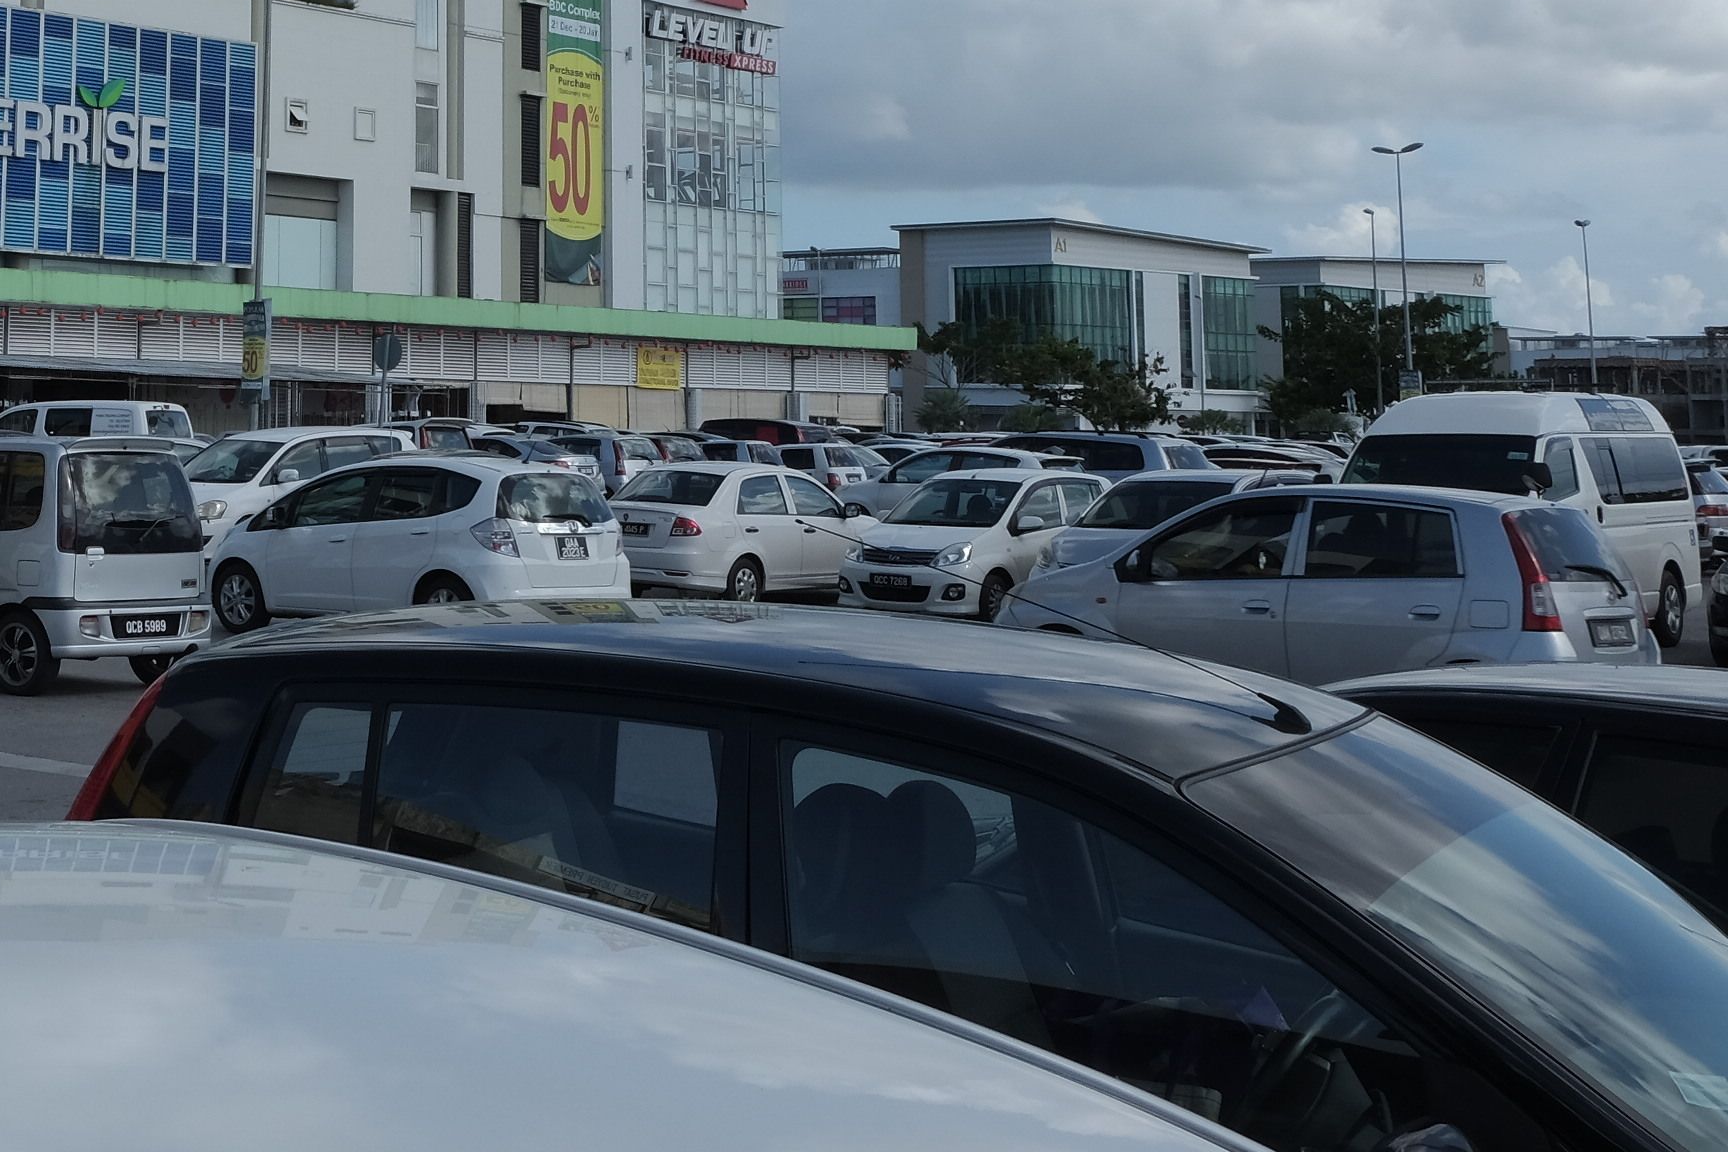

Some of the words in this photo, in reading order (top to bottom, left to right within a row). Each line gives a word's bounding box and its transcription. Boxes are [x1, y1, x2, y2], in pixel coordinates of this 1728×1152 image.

[549, 0, 566, 12] BDC
[568, 4, 600, 20] Complex
[682, 48, 729, 66] FITNESS
[733, 54, 775, 74] XPRESS
[549, 64, 584, 77] Purchase
[585, 71, 601, 81] with
[558, 77, 591, 90] Purchase
[1054, 237, 1067, 253] A1
[243, 350, 258, 374] 50
[144, 619, 167, 633] 5989
